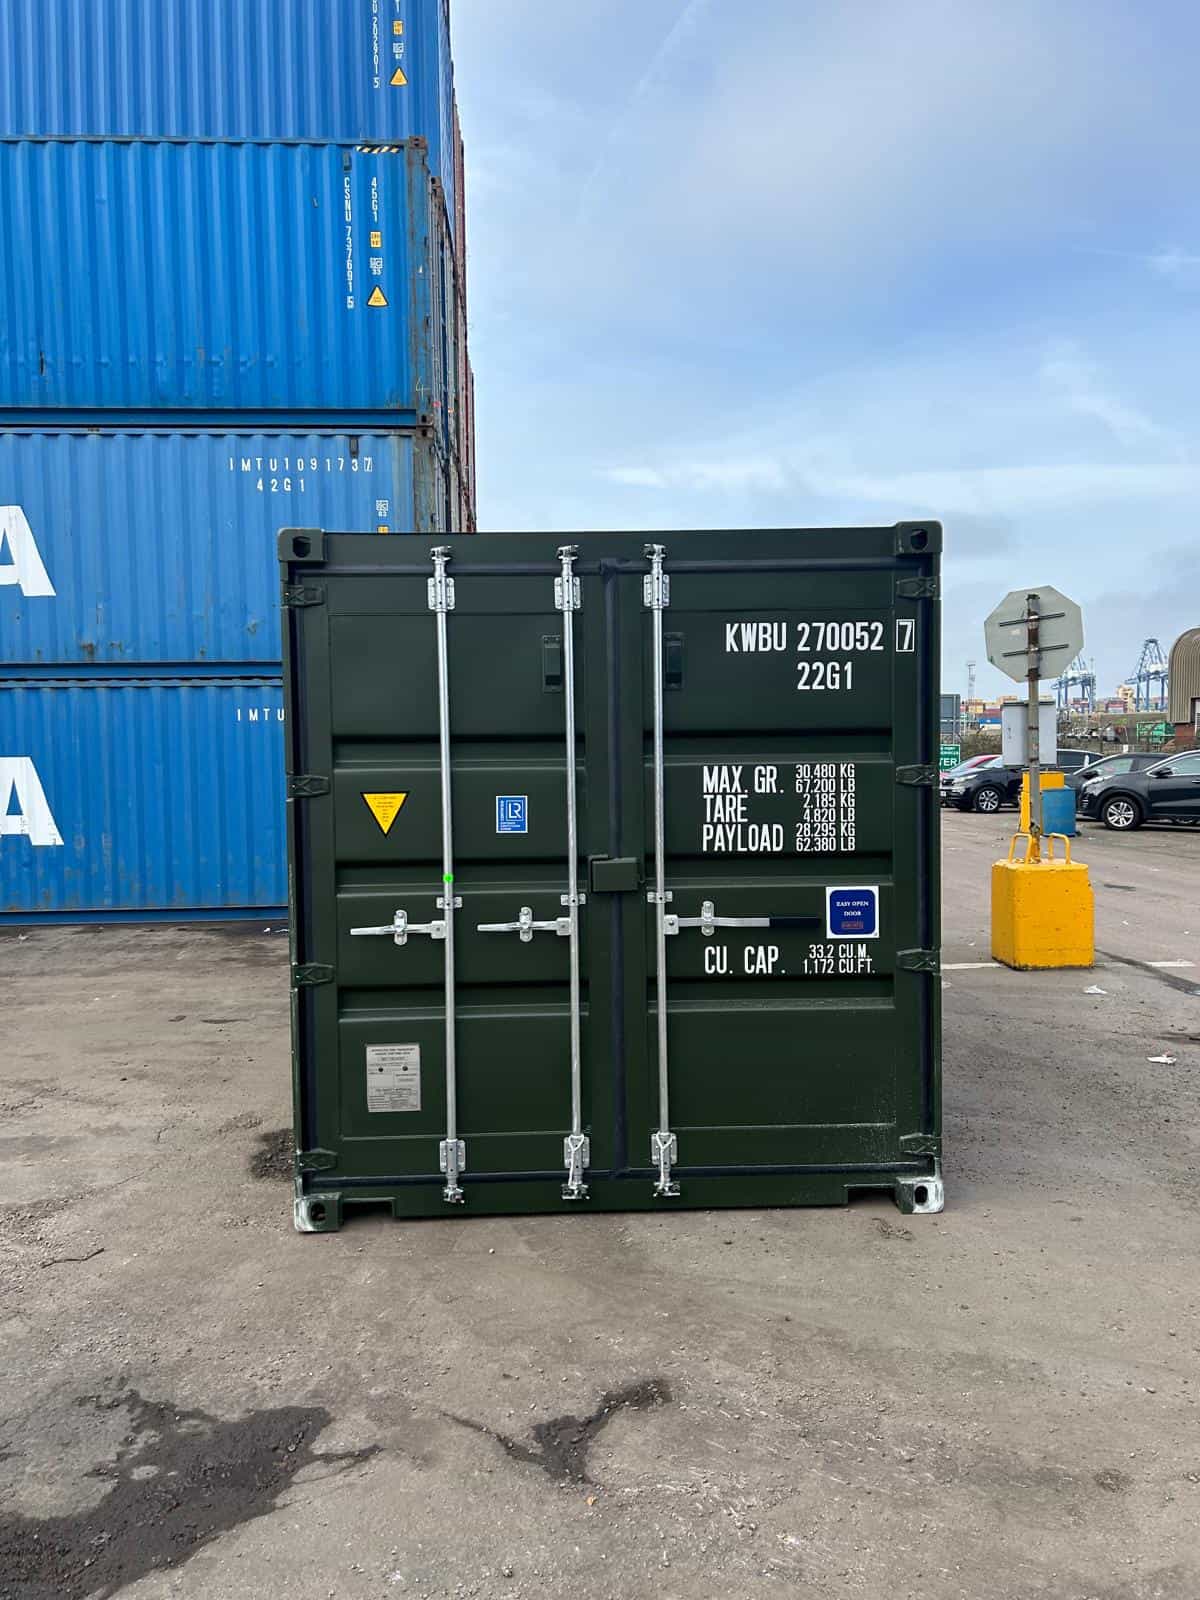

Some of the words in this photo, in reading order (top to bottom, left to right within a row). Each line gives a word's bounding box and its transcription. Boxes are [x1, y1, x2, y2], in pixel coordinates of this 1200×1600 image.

[344, 176, 352, 222] CSNU
[256, 478, 305, 492] 42G1
[725, 622, 787, 652] KWBU
[797, 621, 884, 651] 270052
[797, 661, 852, 690] 22G1
[237, 708, 285, 721] IMTU
[840, 763, 856, 778] KG
[702, 765, 749, 794] MAX.
[754, 765, 785, 794] GR.
[840, 778, 856, 793] LB
[840, 793, 856, 807] KG
[703, 794, 749, 823] TARE
[840, 808, 856, 822] LB
[840, 822, 856, 837] KG
[702, 823, 784, 852] PAYLOAD
[840, 837, 856, 851] LB
[808, 944, 835, 959] 33.2
[704, 945, 733, 974] CU.
[744, 945, 786, 974] CAP.
[838, 958, 876, 974] CU.FT.
